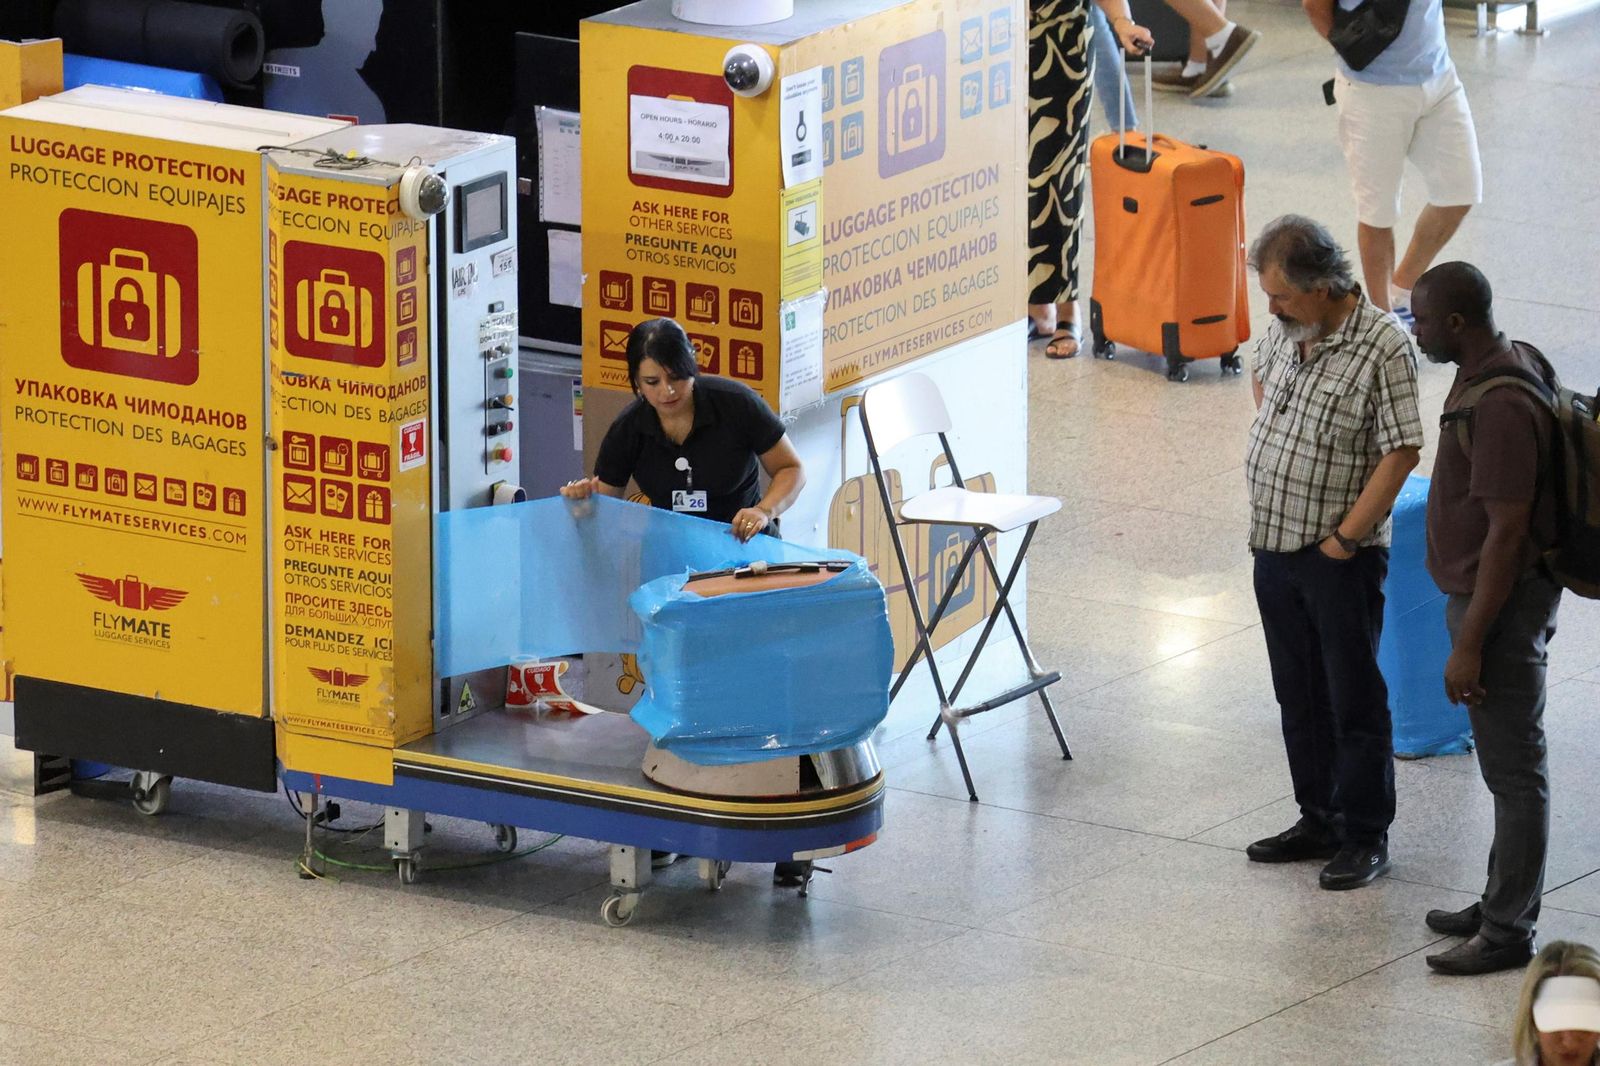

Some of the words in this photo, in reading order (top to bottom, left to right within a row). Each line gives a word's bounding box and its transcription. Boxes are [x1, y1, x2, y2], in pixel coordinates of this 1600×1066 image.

[640, 113, 659, 121] OPEN
[660, 116, 683, 124] HOURS
[688, 119, 718, 129] HORARIO
[10, 135, 106, 165] LUGGAGE
[113, 150, 245, 185] PROTECTION
[10, 163, 138, 198] PROTECCION
[149, 184, 246, 215] EQUIPAJES
[632, 200, 660, 215] ASK
[664, 204, 698, 220] HERE
[702, 210, 729, 225] FOR
[823, 200, 896, 246] LUGGAGE
[900, 163, 999, 218] PROTECTION
[359, 219, 426, 242] EQUIPAJES
[629, 215, 673, 232] OTHER
[676, 221, 732, 240] SERVICES
[823, 224, 920, 279] PROTECCION
[928, 195, 999, 240] EQUIPAJES
[625, 233, 698, 253] PREGUNTE
[701, 244, 737, 259] AQUI
[907, 232, 997, 280] ЧЕМОДАНОВ
[626, 248, 670, 265] OTROS
[673, 255, 736, 275] SERVICIOS
[823, 300, 907, 348] PROTECTION
[913, 288, 937, 313] DES
[943, 265, 999, 302] BAGAGES
[831, 309, 993, 380] WWW.FLYMATESERVICES.COM
[337, 375, 427, 402] ЧИМОДАНОВ
[15, 378, 118, 410] УПАКОВКА
[124, 396, 247, 430] ЧИМОДАНОВ
[344, 404, 372, 421] DES
[379, 399, 428, 423] BAGAGES
[15, 405, 124, 437] PROTECTION
[132, 424, 163, 443] DES
[172, 431, 247, 456] BAGAGES
[689, 498, 705, 508] 26
[18, 496, 247, 545] WWW.FLYMATESERVICES.COM
[284, 525, 312, 539] ASK
[320, 530, 355, 545] HERE
[363, 536, 391, 551] FOR
[284, 539, 330, 556] OTHER
[333, 546, 391, 566] SERVICES
[284, 558, 354, 579] PREGUNTE
[358, 570, 391, 584] AQUI
[284, 572, 327, 590] OTROS
[330, 579, 392, 599] SERVICIOS
[285, 592, 345, 611] ПРОСИТЕ
[349, 601, 392, 618] ЗДЕСЬ
[285, 605, 305, 617] ДЛЯ
[308, 608, 358, 624] БОЛЬШИХ
[94, 611, 171, 639] FLYMATE
[285, 623, 365, 645] DEMANDEZ
[374, 637, 392, 650] ICI
[94, 629, 132, 643] LUGGAGE
[134, 635, 171, 649] SERVICES
[285, 637, 310, 649] POUR
[313, 641, 335, 653] PLUS
[337, 645, 350, 655] DE
[352, 647, 393, 661] SERVICES
[526, 666, 551, 674] CUIDADO
[316, 687, 360, 703] FLYMATE
